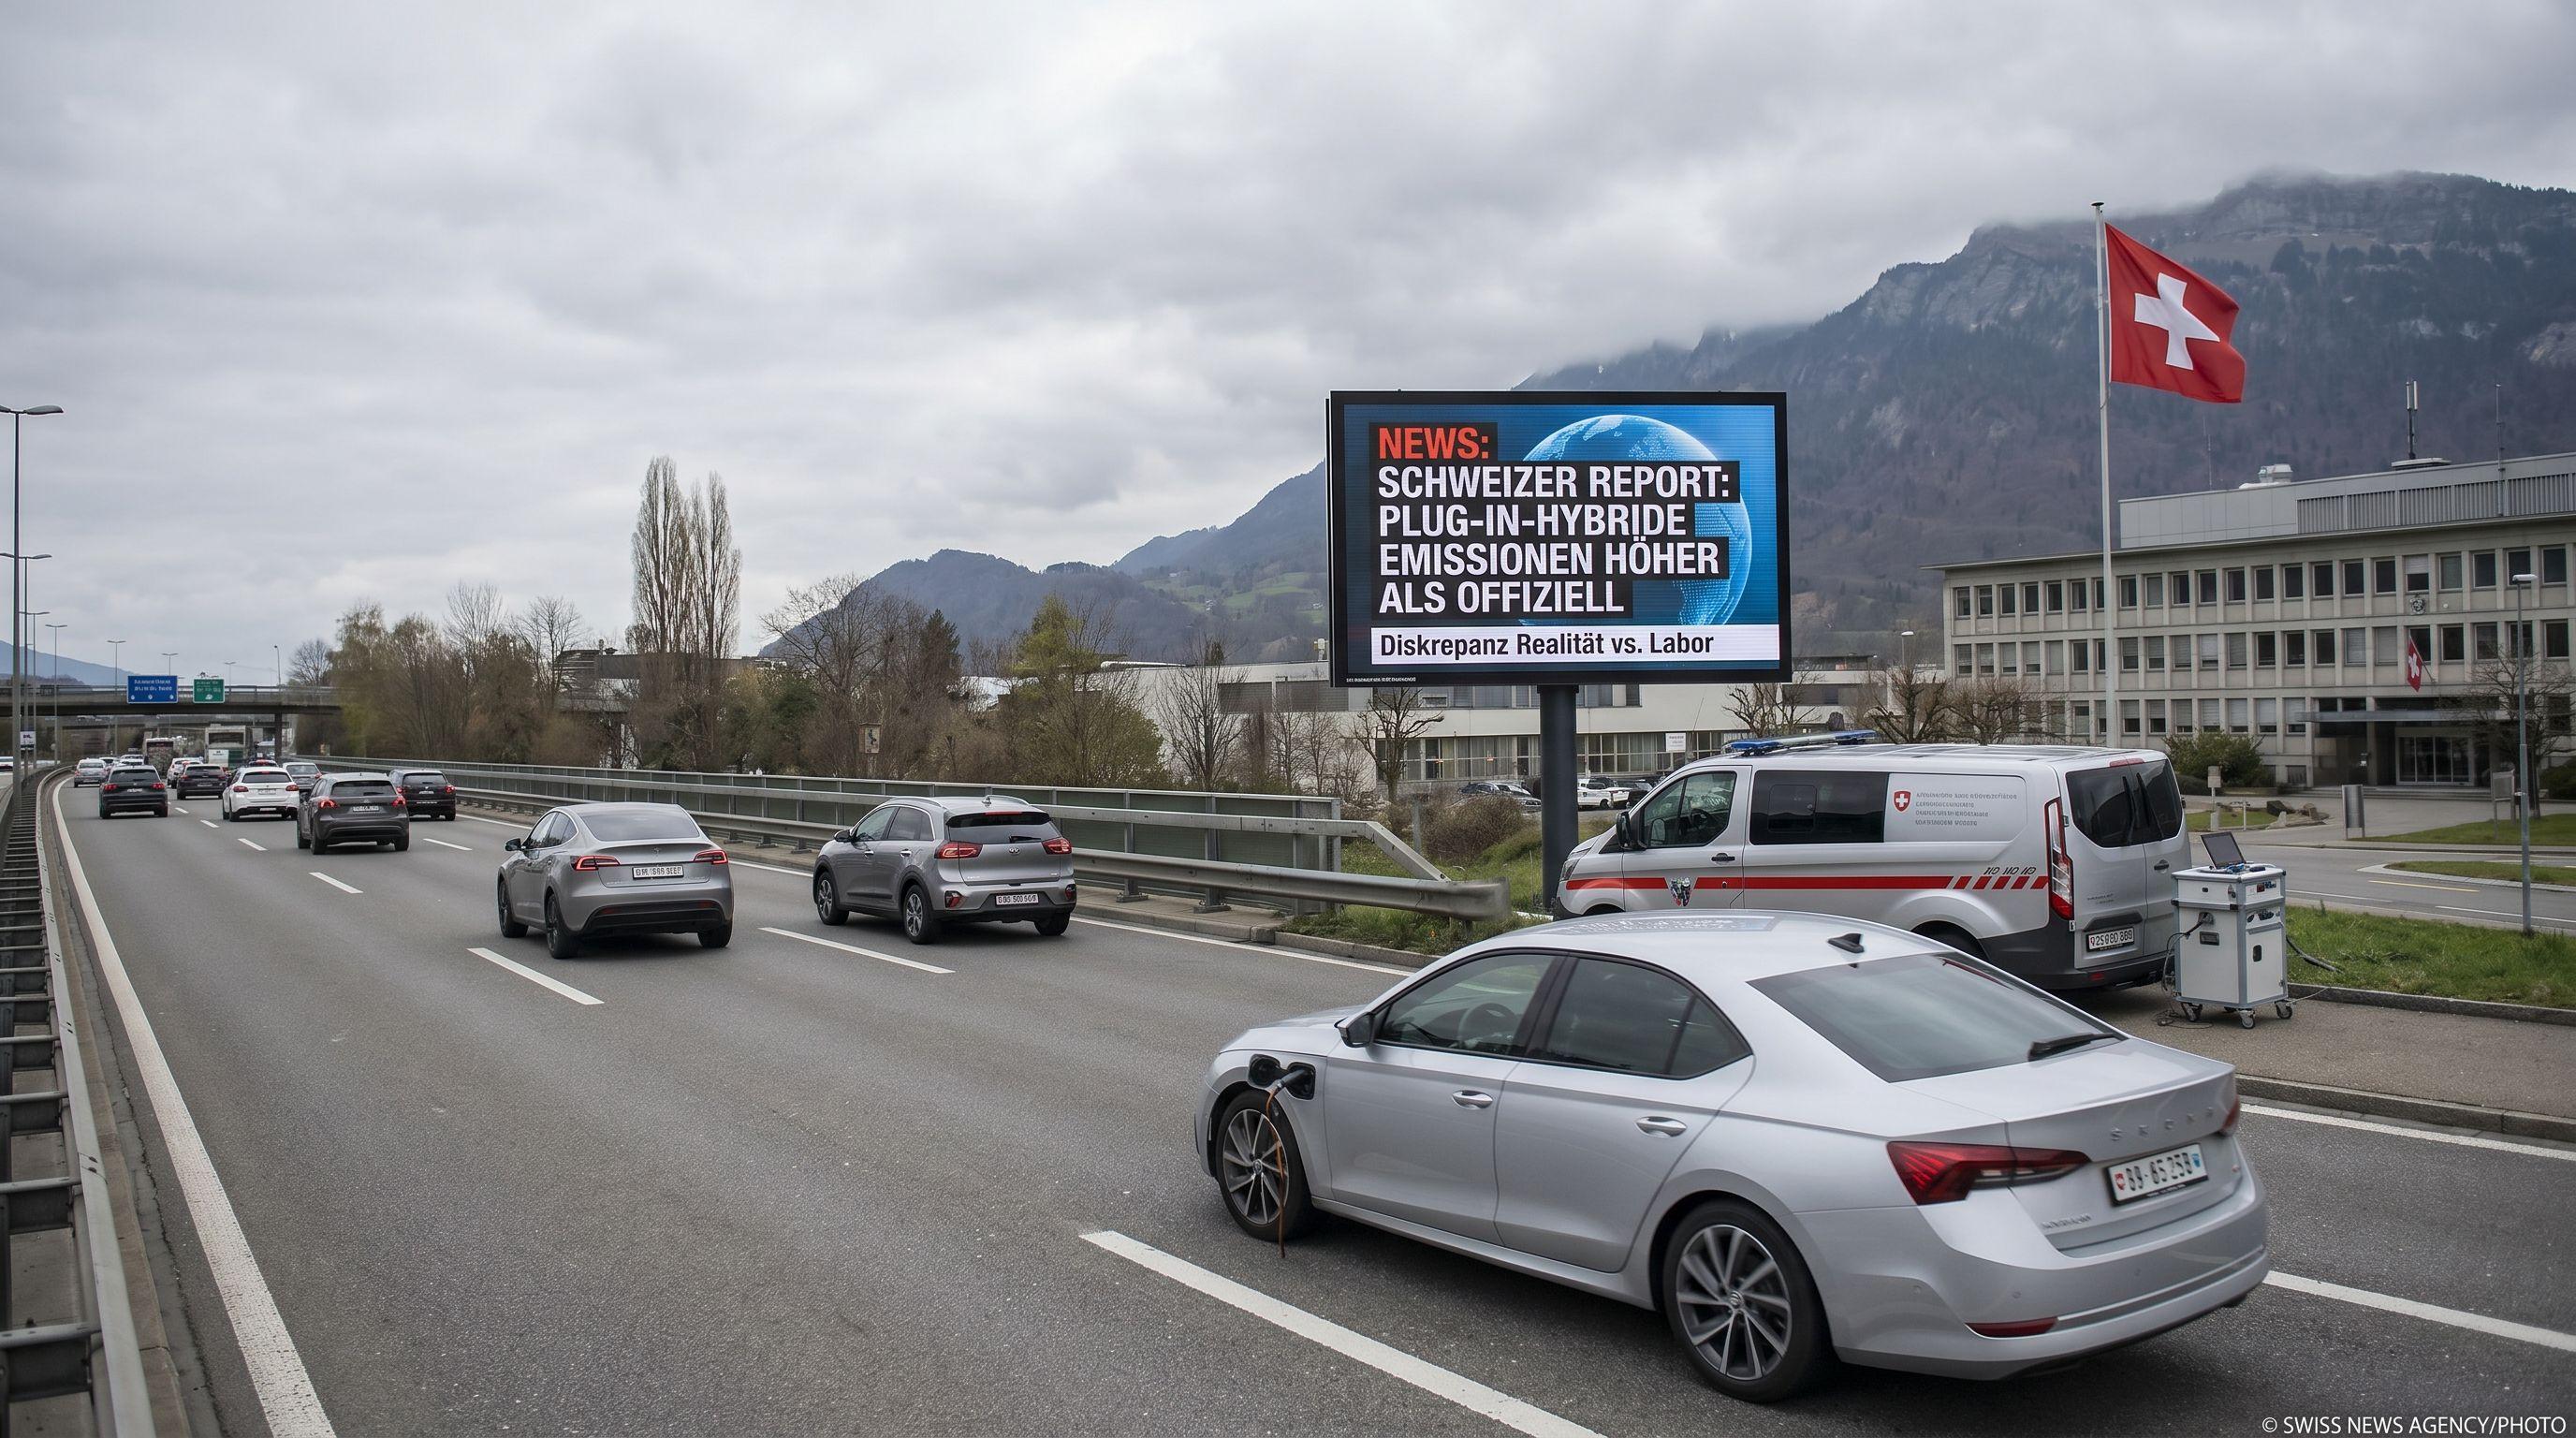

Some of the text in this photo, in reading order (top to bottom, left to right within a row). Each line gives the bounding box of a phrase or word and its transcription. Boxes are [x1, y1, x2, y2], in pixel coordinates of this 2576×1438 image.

[1379, 427, 1489, 459] NEWS:
[1379, 465, 1729, 498] SCHWEIZER REPORT:
[1380, 504, 1687, 536] PLUG-IN-HYBRIDE
[1380, 536, 1720, 576] EMISSIONEN HÖHER
[1379, 580, 1624, 614] ALS OFFIZIELL
[1381, 632, 1715, 661] Diskrepanz Realität vs. Labor
